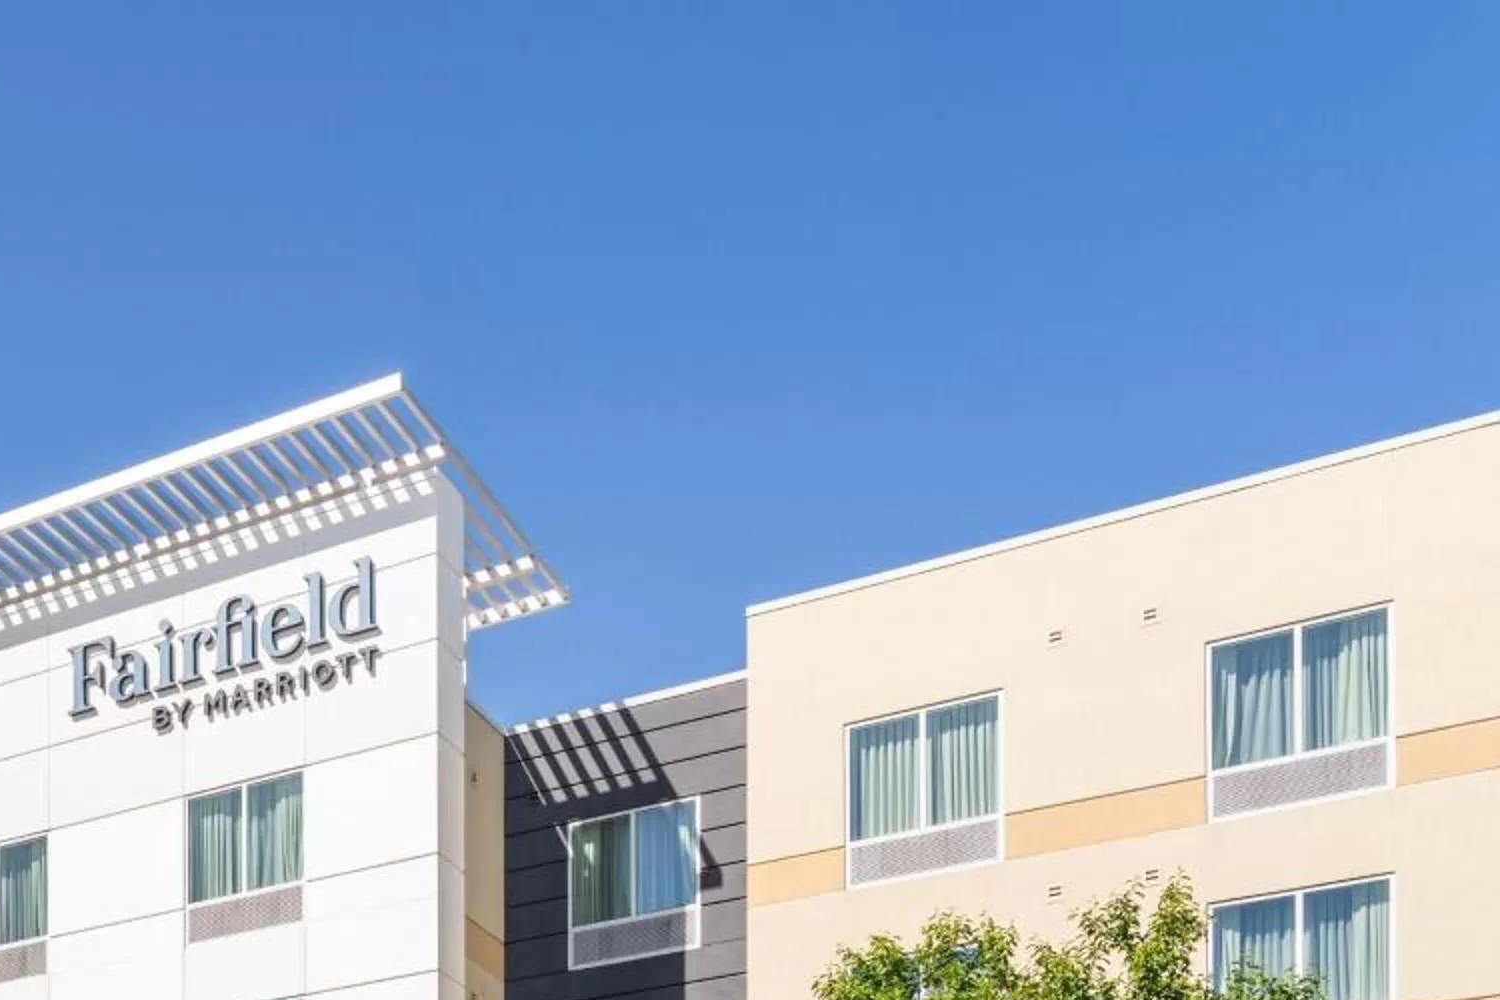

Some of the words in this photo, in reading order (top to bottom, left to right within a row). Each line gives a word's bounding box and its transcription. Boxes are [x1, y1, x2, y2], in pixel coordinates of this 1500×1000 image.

[68, 555, 383, 722] Fairfield
[152, 700, 195, 735] BY
[203, 645, 383, 722] MARRIOTT
